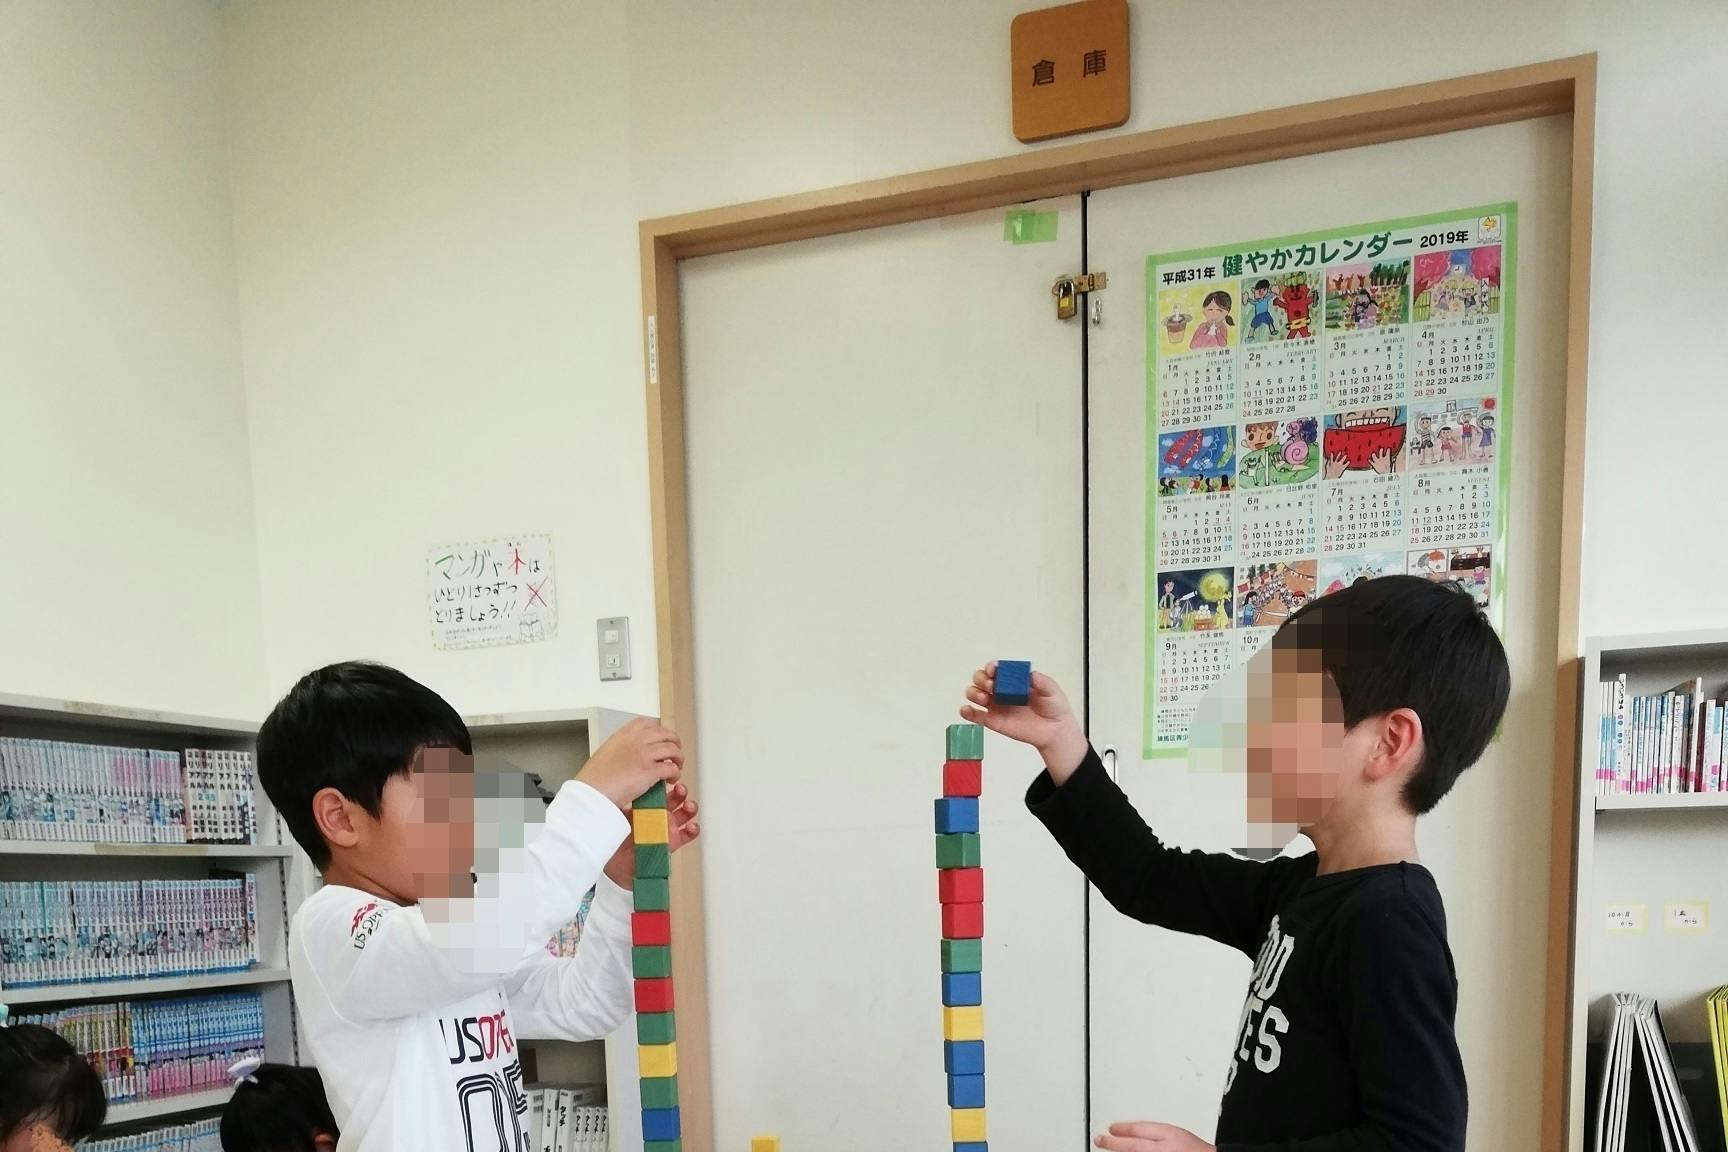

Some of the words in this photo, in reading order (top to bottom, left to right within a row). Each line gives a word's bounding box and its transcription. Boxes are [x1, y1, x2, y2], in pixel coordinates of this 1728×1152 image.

[1031, 49, 1107, 87] 倉庫
[1162, 266, 1216, 286] 平成31年
[1222, 231, 1413, 278] 健やかカレンダー
[1419, 229, 1469, 249] 2019年
